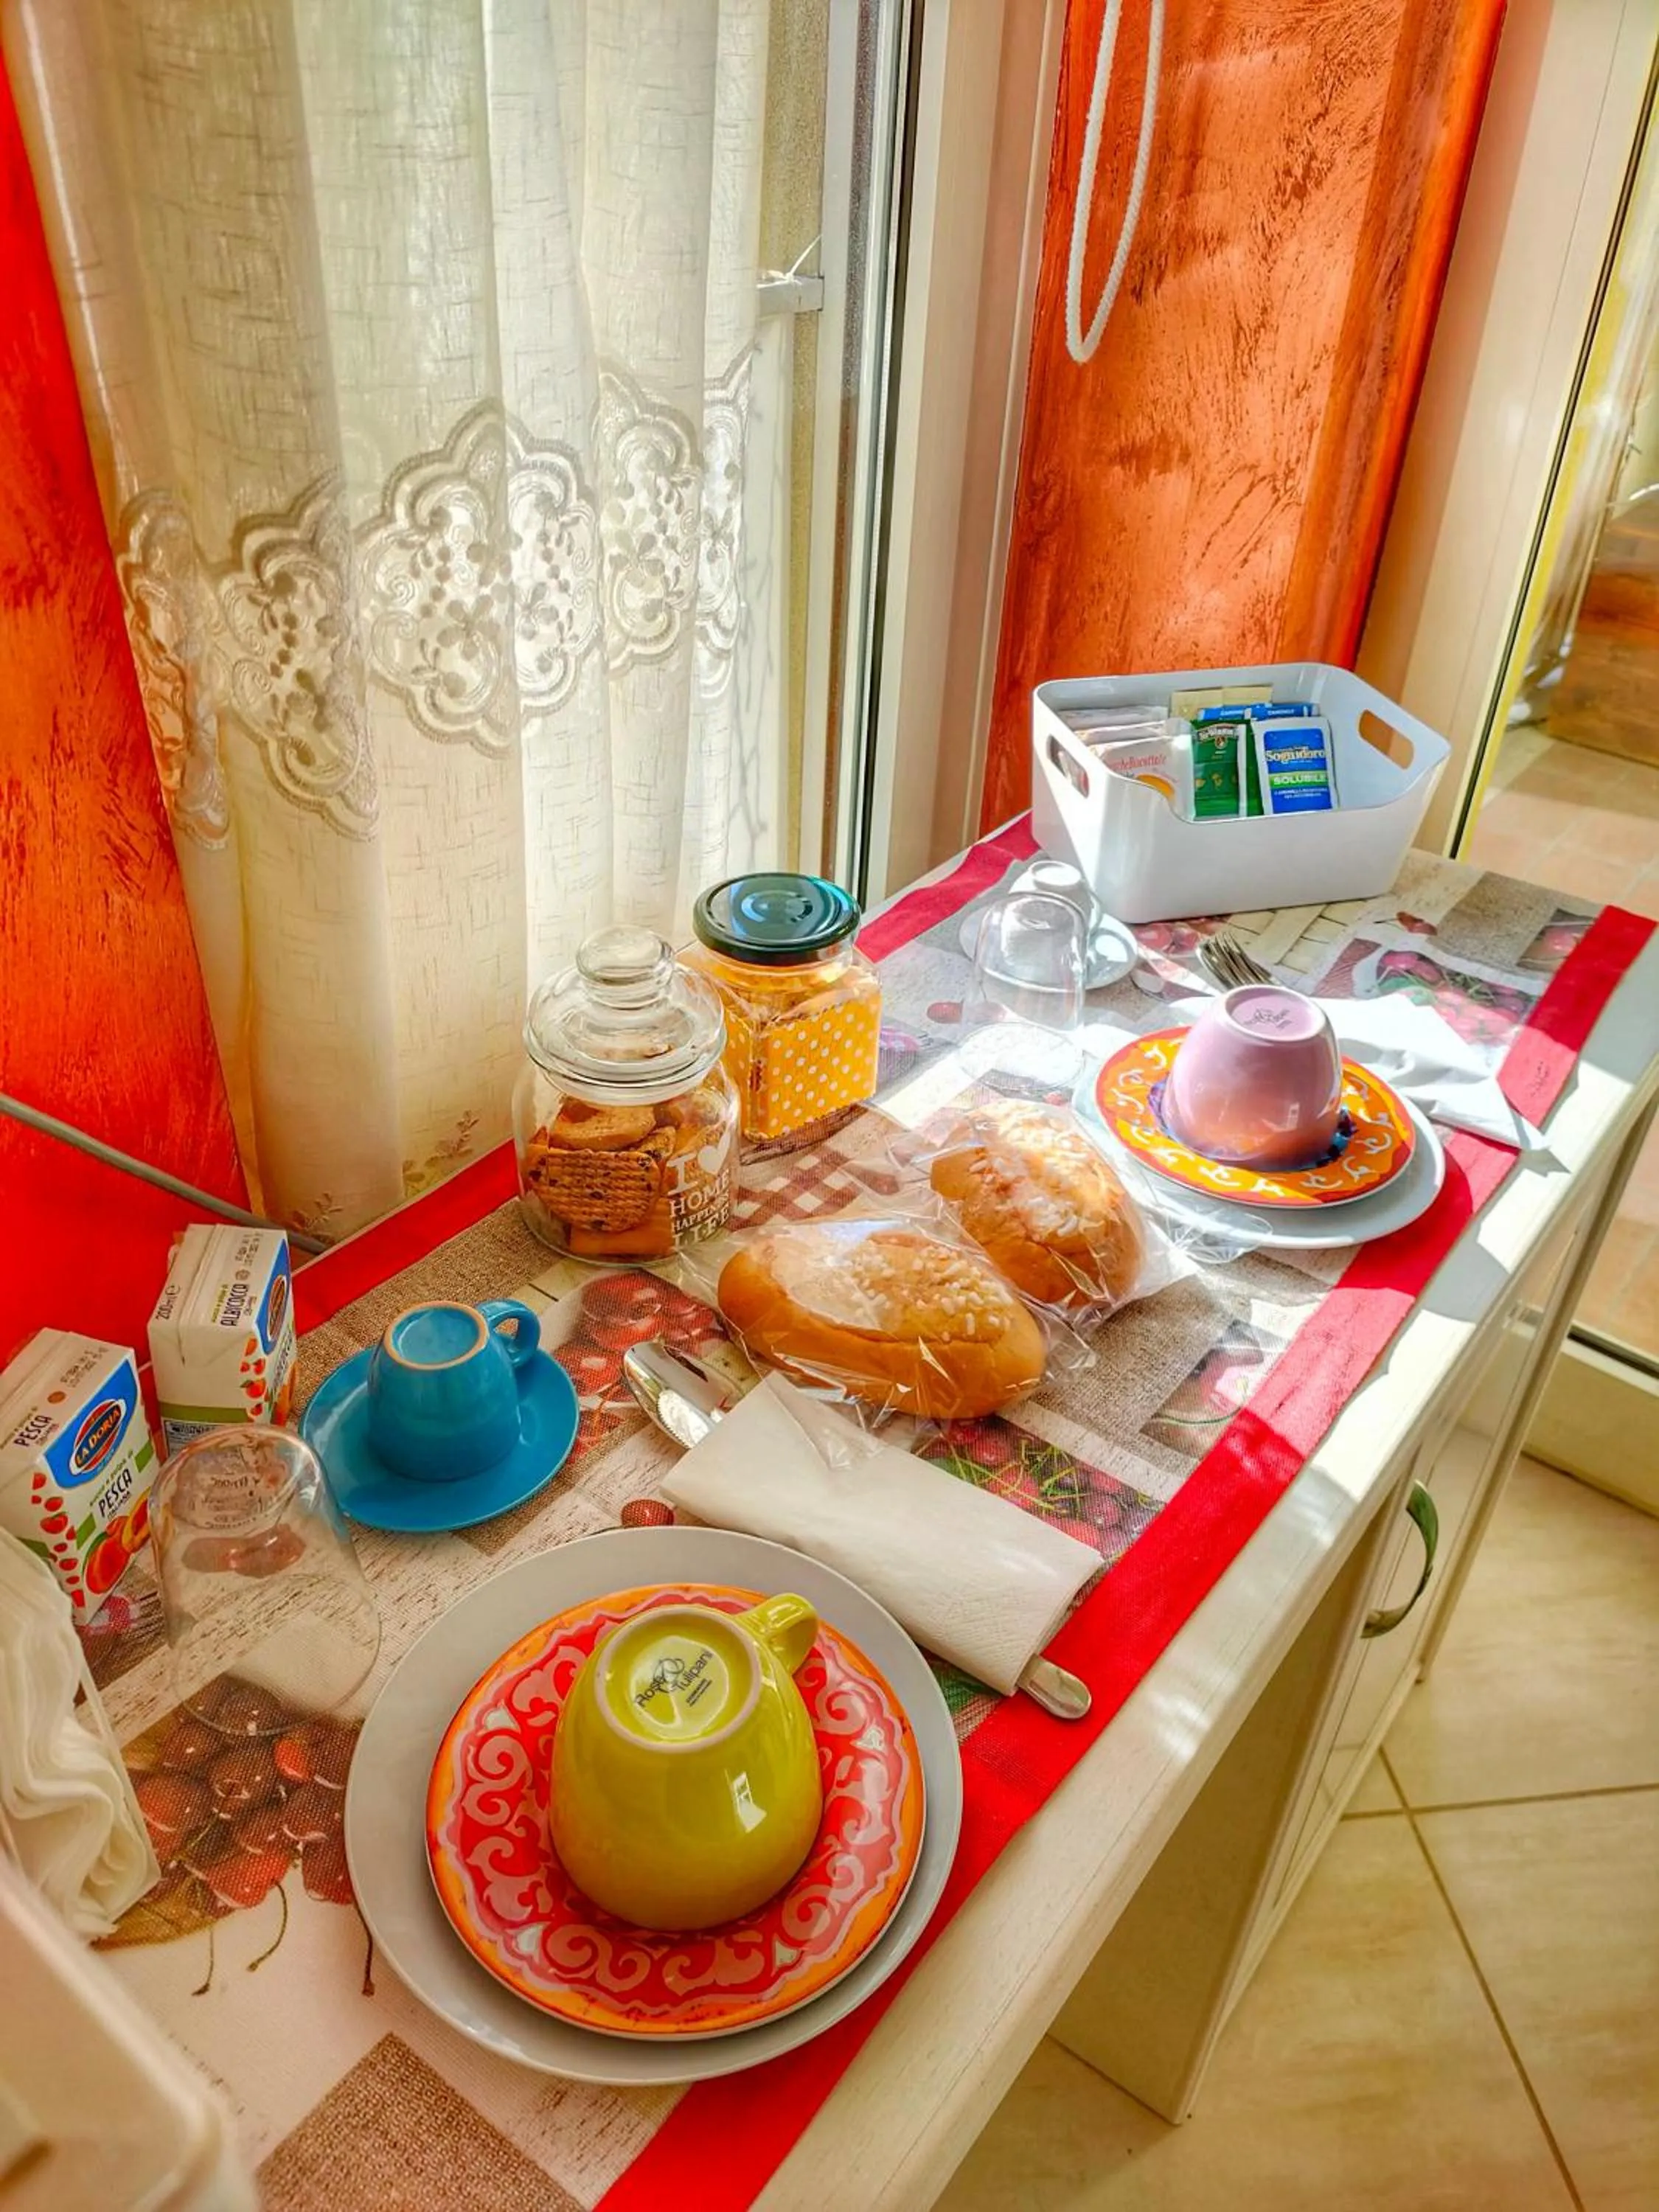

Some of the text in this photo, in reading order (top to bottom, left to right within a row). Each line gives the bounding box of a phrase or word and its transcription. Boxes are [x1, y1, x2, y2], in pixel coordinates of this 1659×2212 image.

[667, 1152, 698, 1196] I
[669, 1168, 730, 1217] HOME
[672, 1203, 730, 1252] LIFE
[220, 1283, 249, 1326] ALBICOCCA
[14, 1414, 54, 1447] PESCA
[75, 1448, 89, 1467] LA
[88, 1410, 121, 1447] DORIA
[98, 1468, 133, 1517] PESCA
